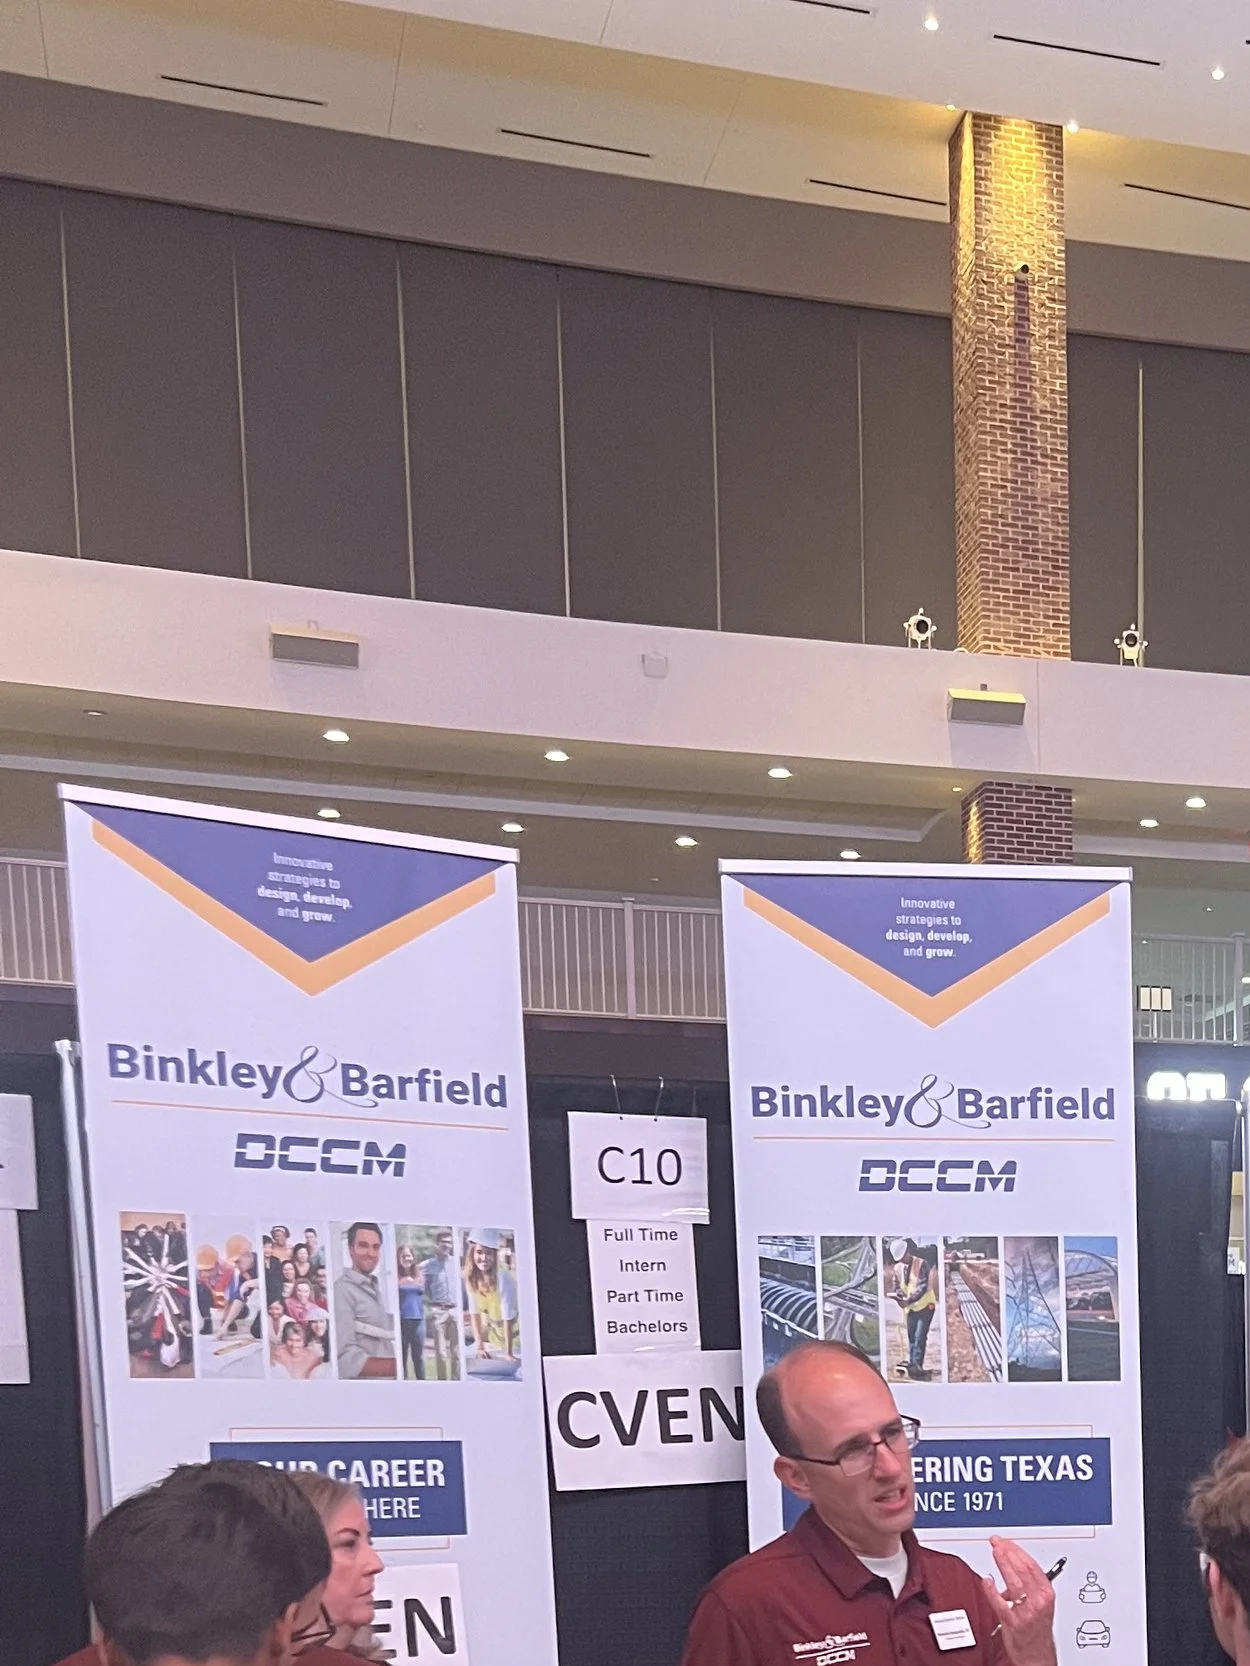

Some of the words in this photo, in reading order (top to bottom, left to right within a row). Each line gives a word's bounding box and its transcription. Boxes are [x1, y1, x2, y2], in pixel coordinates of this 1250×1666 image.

[273, 852, 333, 871] Innovative
[268, 872, 326, 888] strategies
[328, 879, 340, 889] to
[277, 907, 299, 919] and
[901, 897, 955, 909] Innovative
[896, 915, 948, 927] strategies
[951, 916, 962, 925] to
[886, 929, 924, 943] design,
[927, 930, 972, 944] develop,
[904, 946, 923, 957] and
[925, 948, 956, 959] grow.
[108, 1043, 283, 1099] Binkley
[283, 1045, 378, 1108] &
[340, 1062, 508, 1108] Barfield
[751, 1085, 905, 1127] Binkley
[904, 1074, 991, 1129] &
[957, 1086, 1115, 1120] Barfield
[234, 1132, 406, 1177] DCCM
[597, 1147, 682, 1186] C10
[858, 1159, 1017, 1193] DCCM
[604, 1228, 634, 1242] Full
[639, 1228, 678, 1242] Time
[620, 1258, 666, 1272] Intern
[607, 1289, 640, 1303] Part
[644, 1289, 684, 1302] Time
[607, 1319, 688, 1334] Bachelors
[556, 1387, 745, 1448] CVEN
[328, 1459, 446, 1488] CAREER
[911, 1456, 993, 1483] ERING
[1000, 1454, 1094, 1481] TEXAS
[363, 1497, 421, 1519] HERE
[914, 1492, 956, 1512] NCE
[963, 1491, 1004, 1511] 1971
[372, 1596, 457, 1658] EN
